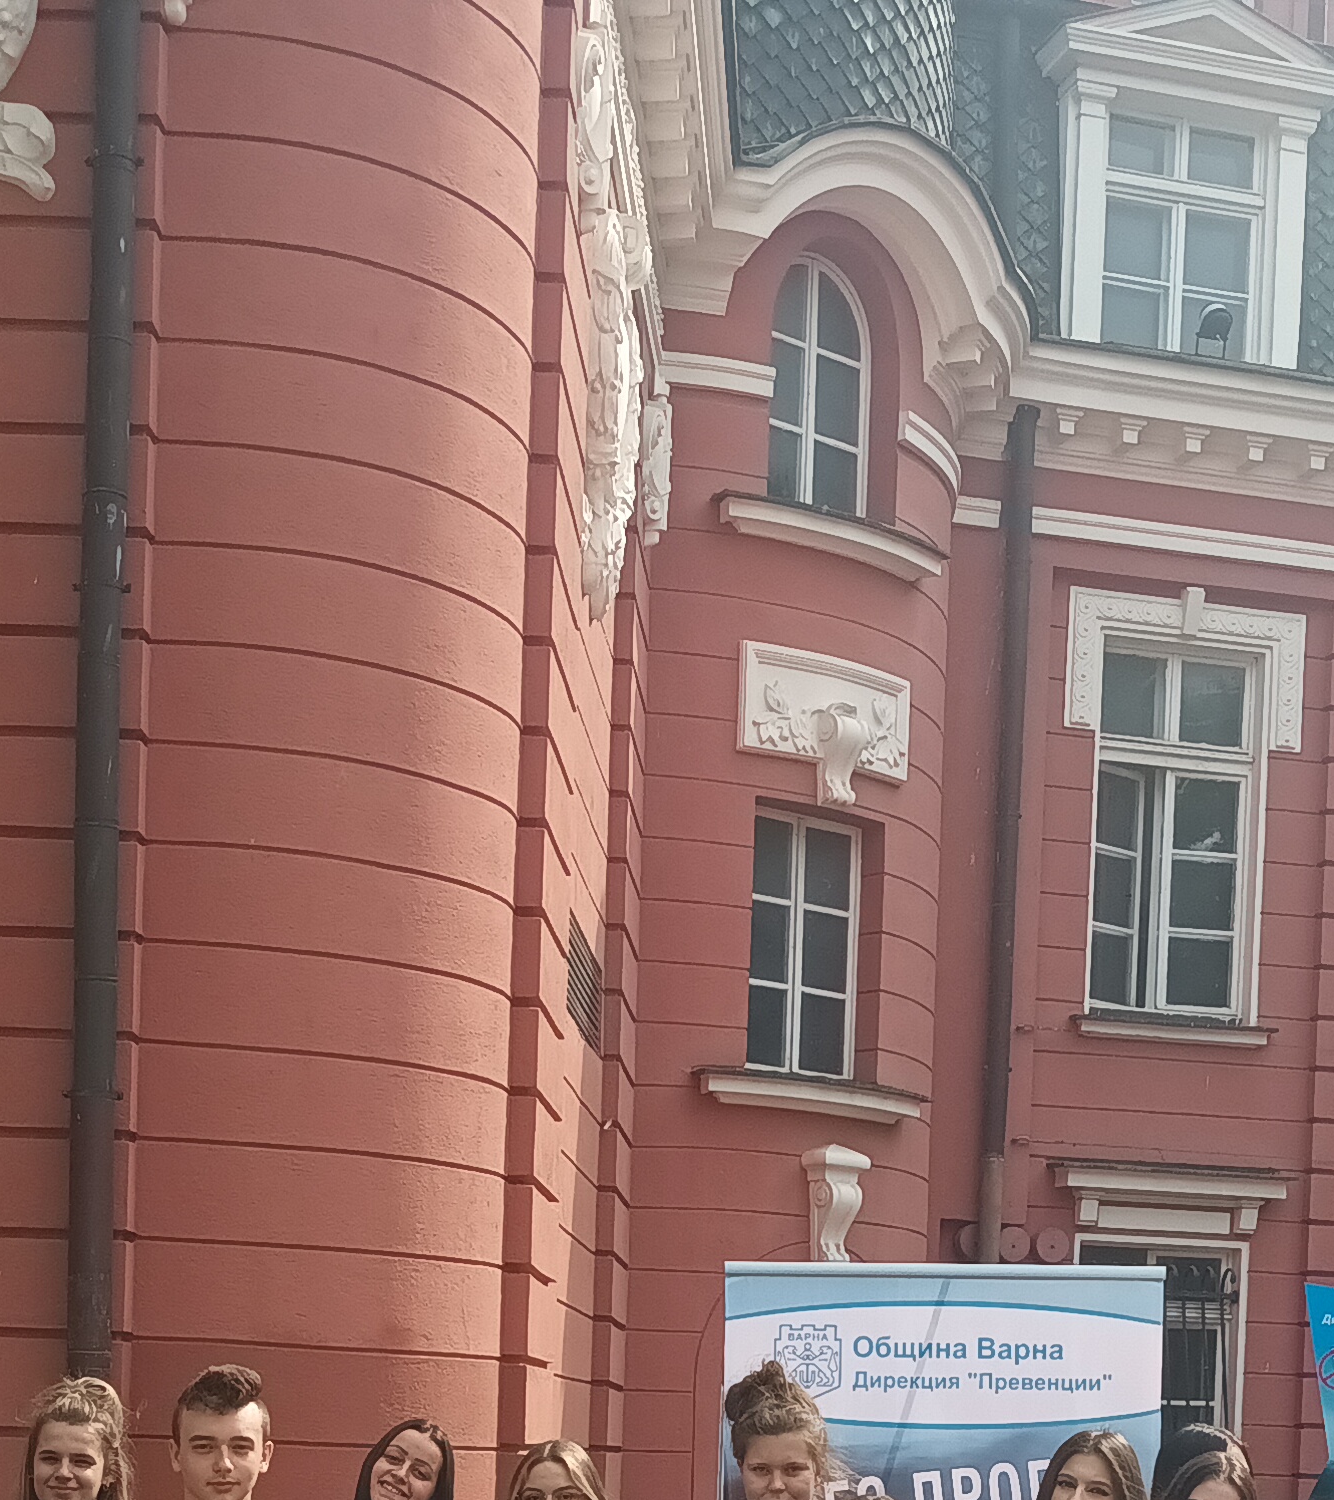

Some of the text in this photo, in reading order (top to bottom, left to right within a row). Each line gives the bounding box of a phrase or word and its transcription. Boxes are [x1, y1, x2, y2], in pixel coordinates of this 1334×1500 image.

[788, 1332, 829, 1342] ВАРНА
[853, 1335, 1064, 1363] Община Варна
[852, 1371, 1112, 1394] Дирекция "Превенции"
